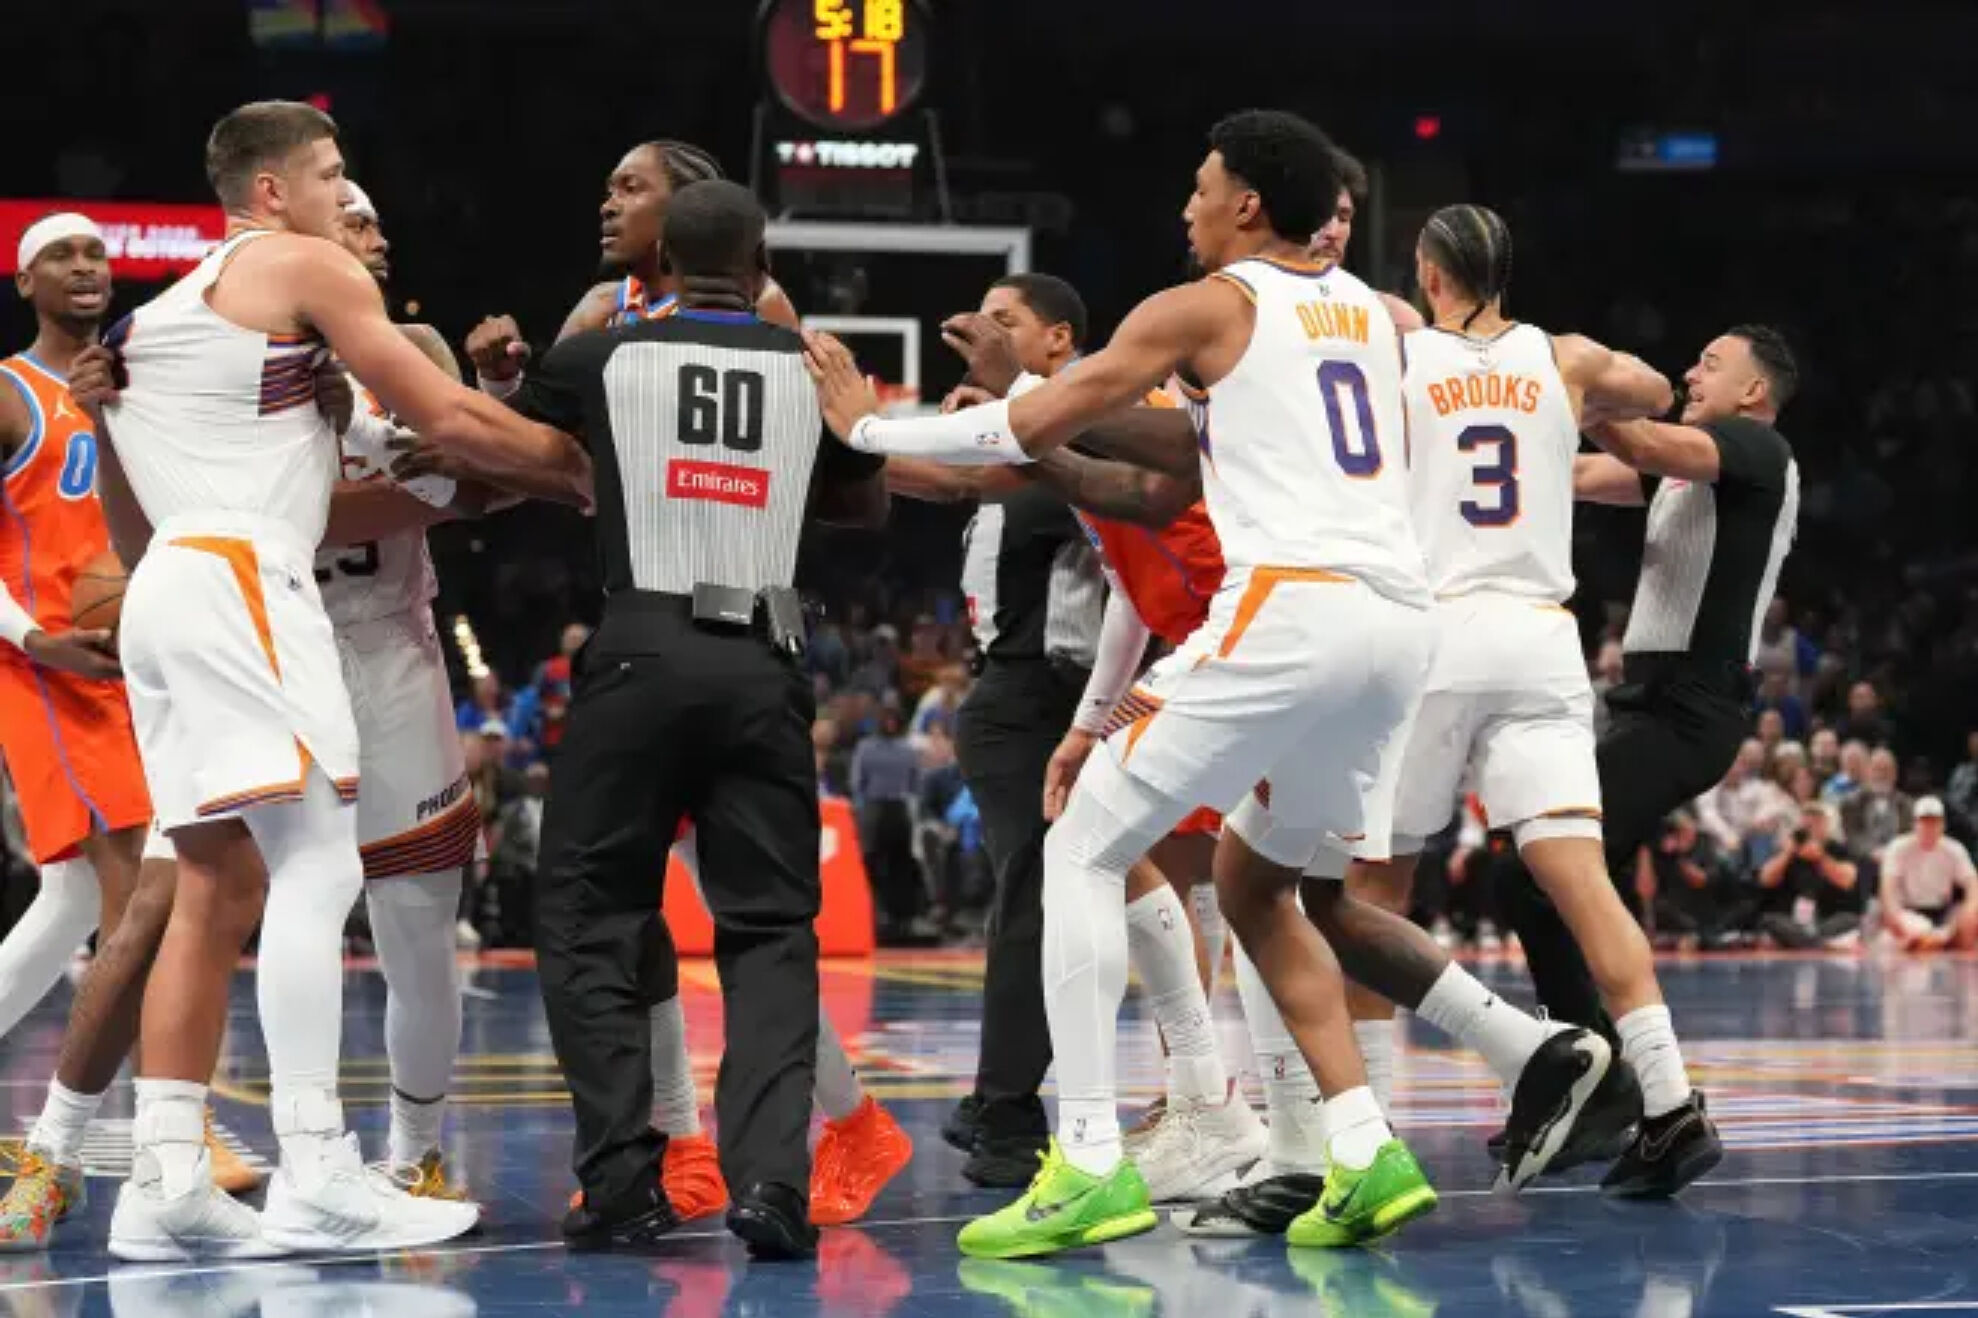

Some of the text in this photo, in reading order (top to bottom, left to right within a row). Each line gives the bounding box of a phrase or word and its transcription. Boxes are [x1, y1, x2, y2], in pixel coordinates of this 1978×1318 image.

[815, 0, 903, 40] 5:18
[830, 39, 895, 115] 17
[1296, 301, 1370, 344] DUNN
[677, 363, 764, 452] 60
[1317, 359, 1383, 480] 0
[1427, 374, 1543, 416] BROOKS
[677, 467, 760, 497] Emirates
[1457, 424, 1520, 528] 3
